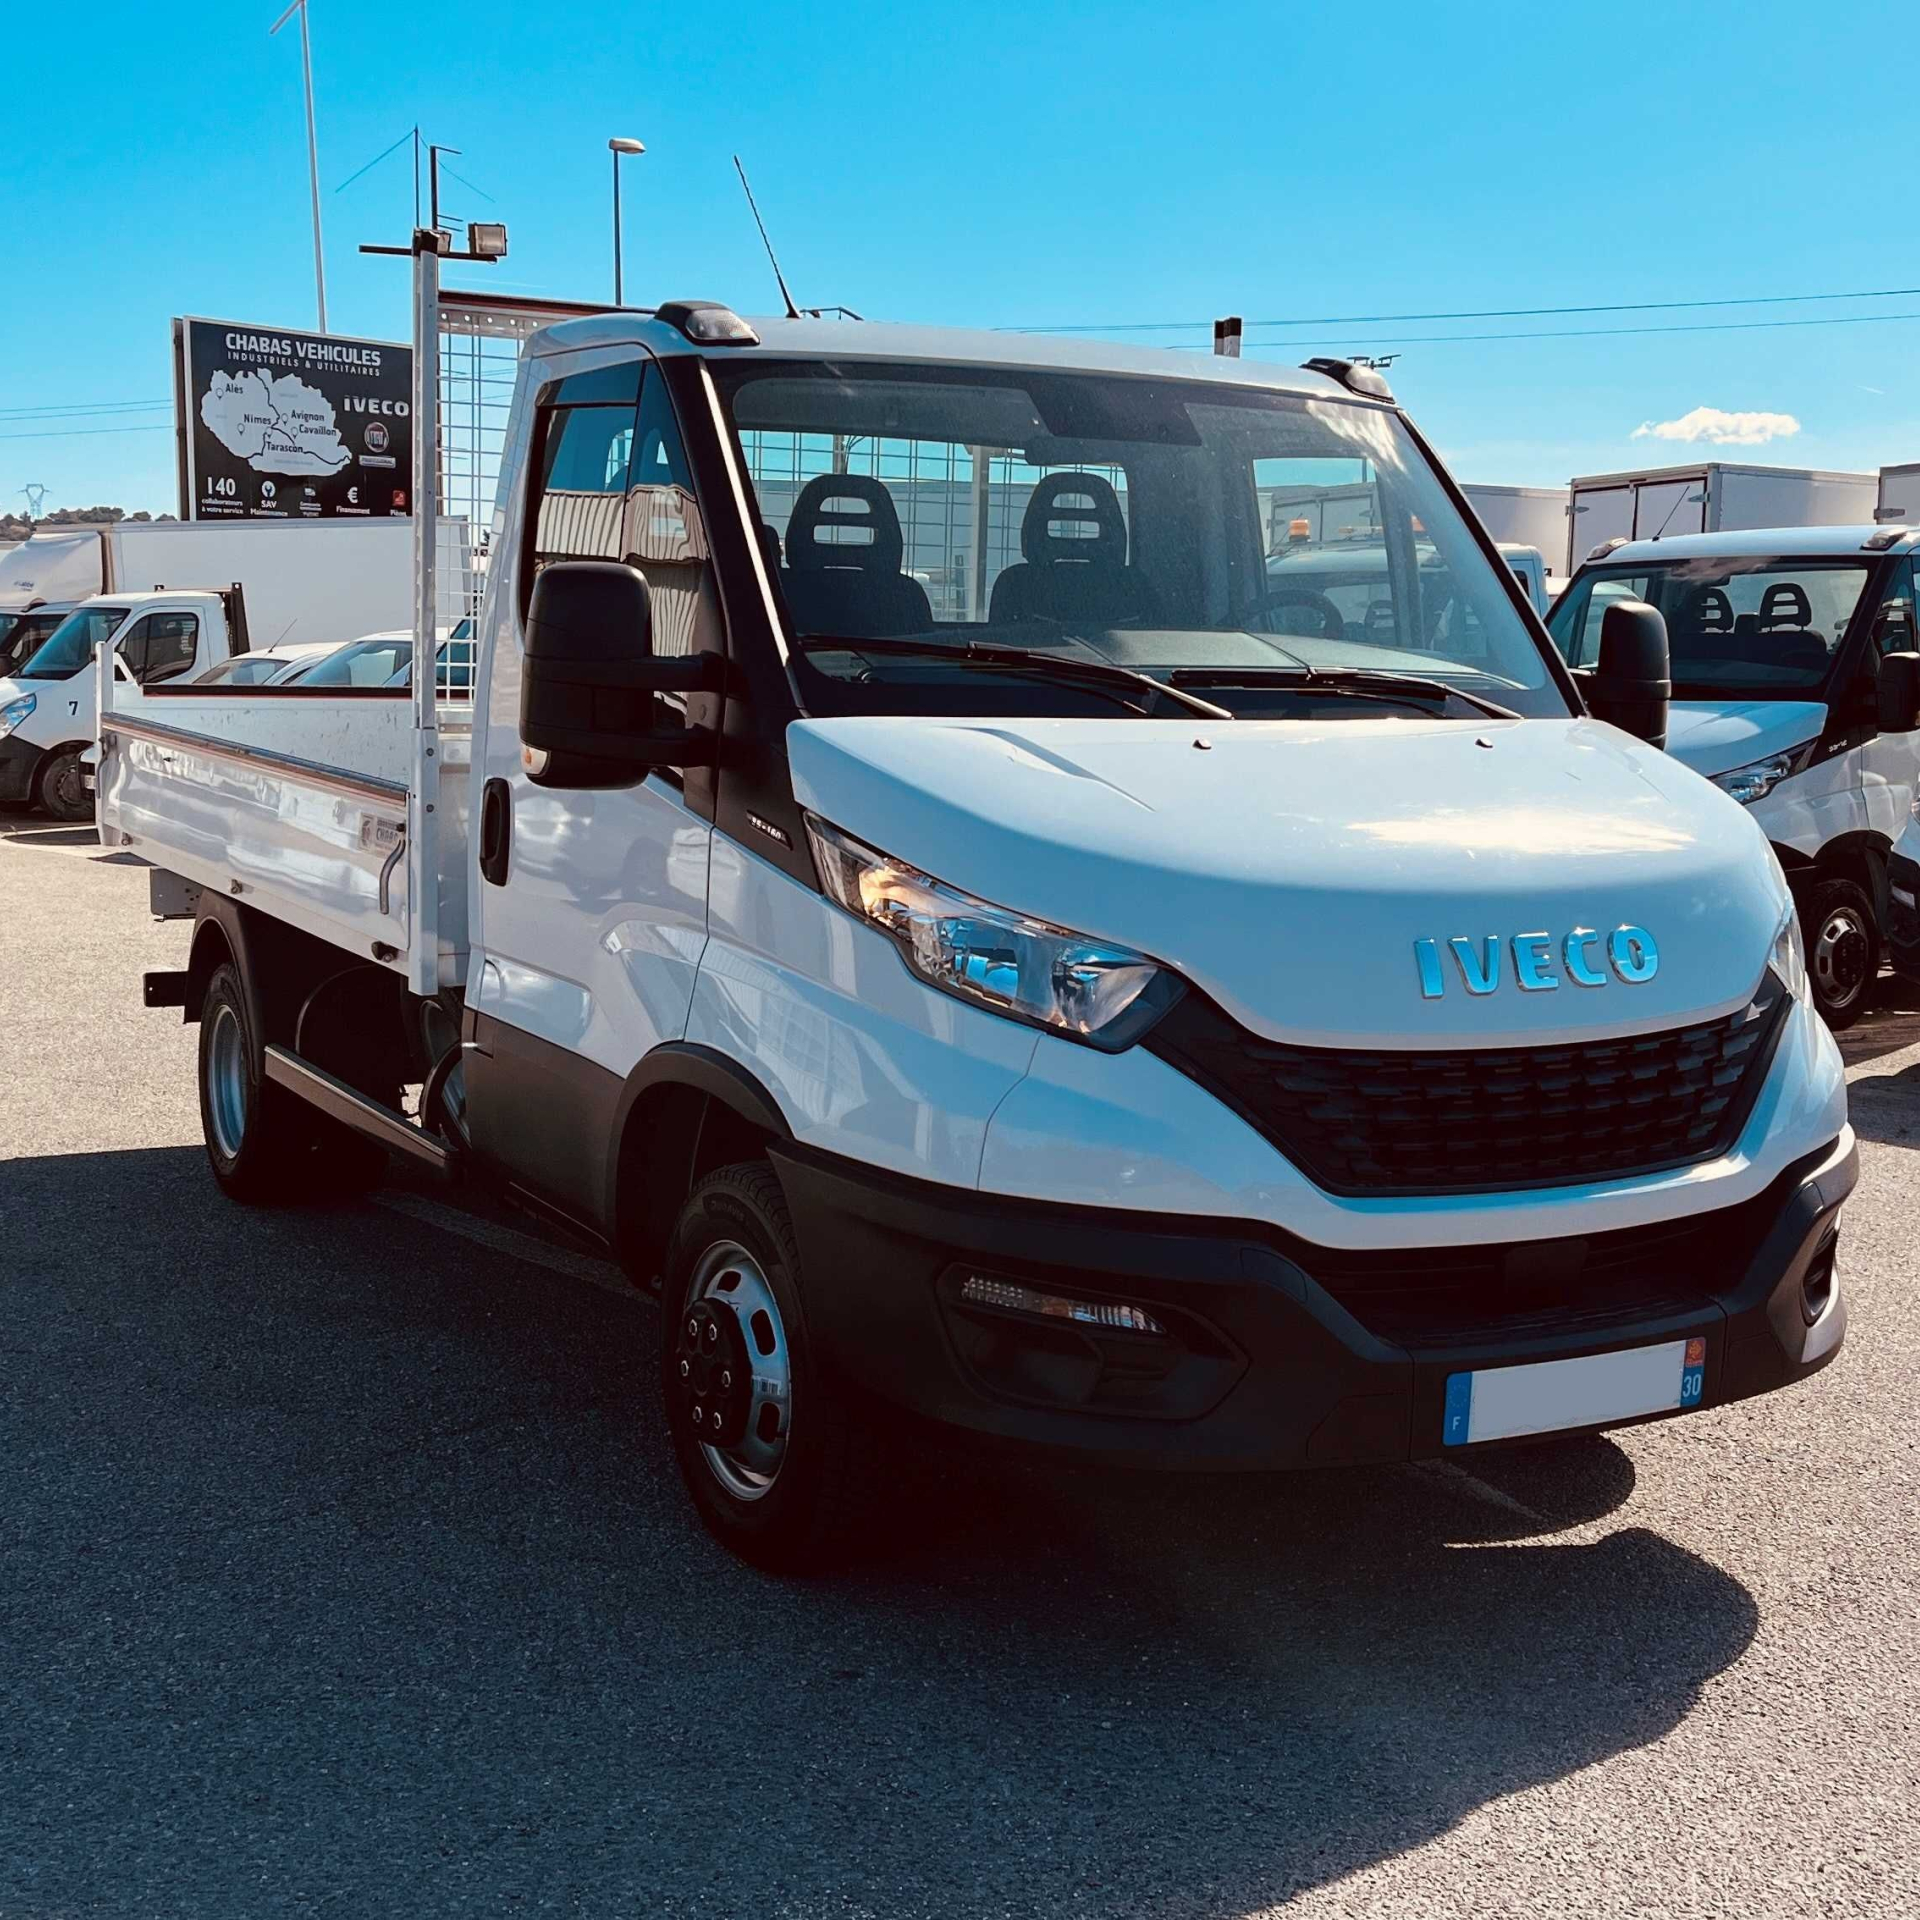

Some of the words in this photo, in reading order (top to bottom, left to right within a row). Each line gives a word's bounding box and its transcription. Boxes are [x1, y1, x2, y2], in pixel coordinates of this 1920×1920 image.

[225, 333, 292, 356] CHABAS
[296, 341, 382, 366] VEHICULES
[227, 351, 299, 367] INDUSTRIELS
[305, 361, 311, 369] &
[317, 362, 380, 377] UTILITAIRES
[344, 395, 409, 416] IVECO
[291, 409, 325, 422] Avignon
[299, 424, 337, 436] Cavaillon
[266, 441, 303, 453] Tarascon
[207, 477, 236, 496] 140
[261, 500, 277, 508] SAV
[68, 701, 79, 715] 7
[1414, 924, 1659, 999] IVECO
[1682, 1373, 1702, 1398] 30
[1452, 1416, 1461, 1430] F
